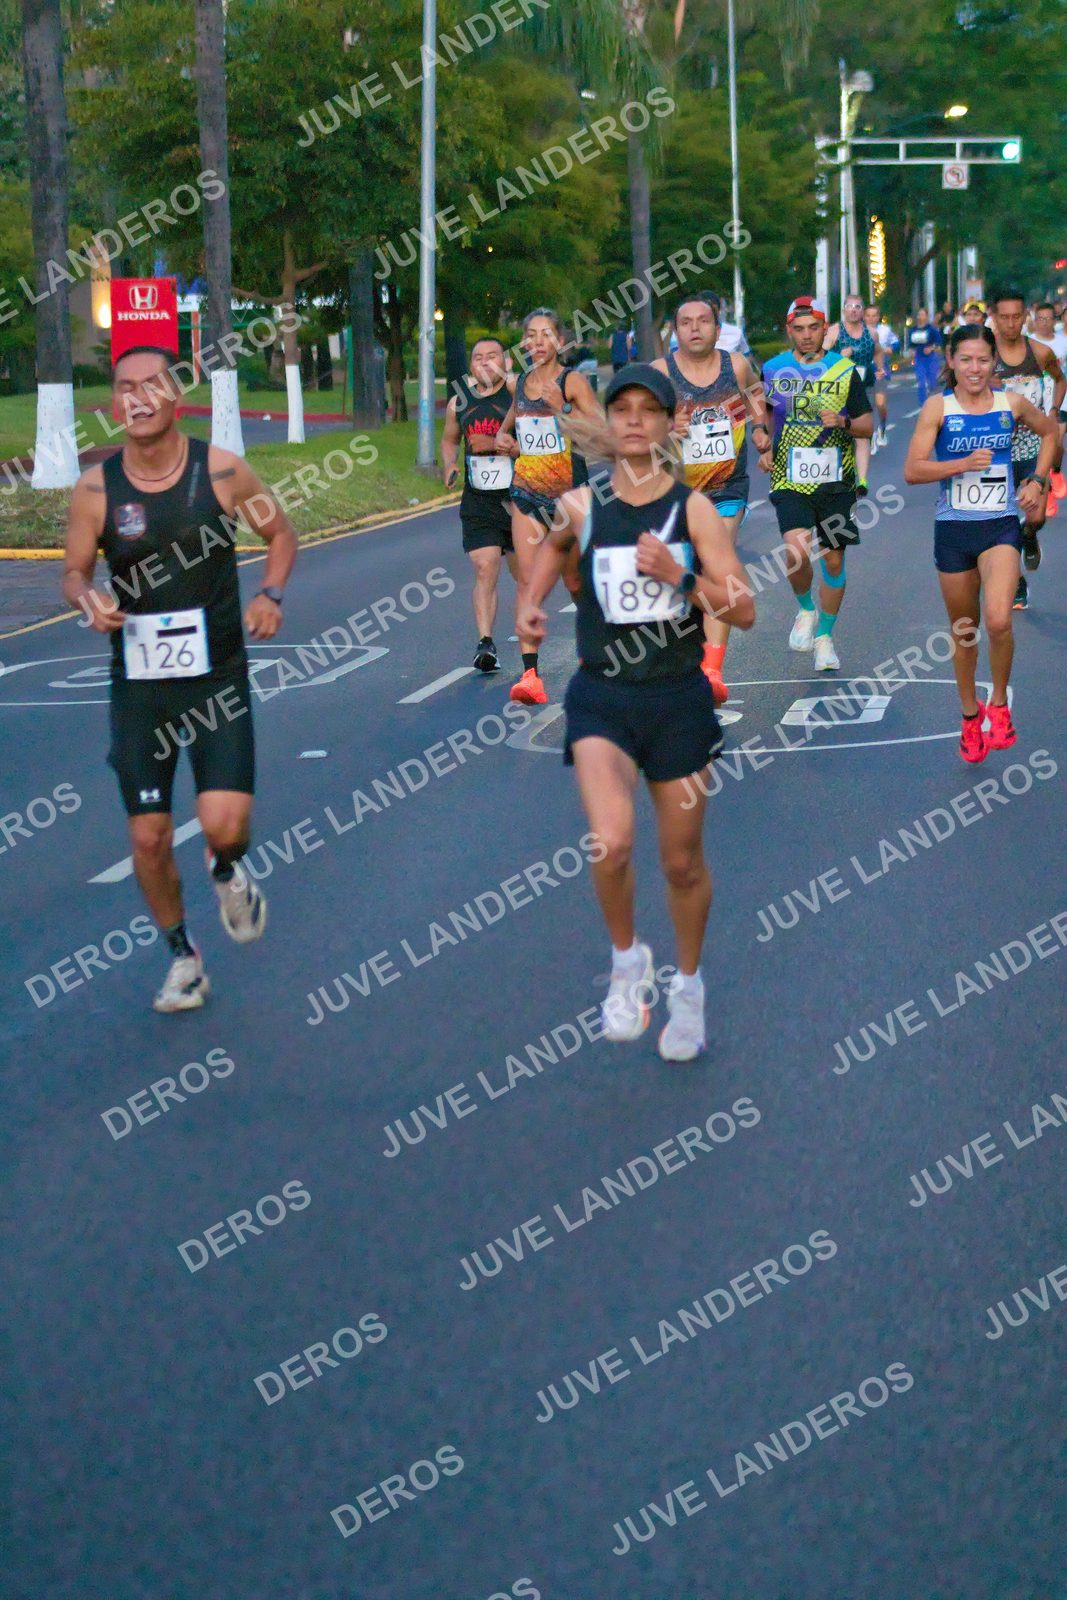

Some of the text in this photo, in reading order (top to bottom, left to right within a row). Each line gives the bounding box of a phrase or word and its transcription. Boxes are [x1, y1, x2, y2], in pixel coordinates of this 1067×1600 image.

[117, 310, 171, 321] HONDA
[691, 438, 727, 459] 340
[481, 470, 500, 485] 97
[799, 463, 831, 479] 804
[956, 484, 1006, 505] 1072
[138, 640, 195, 669] 126
